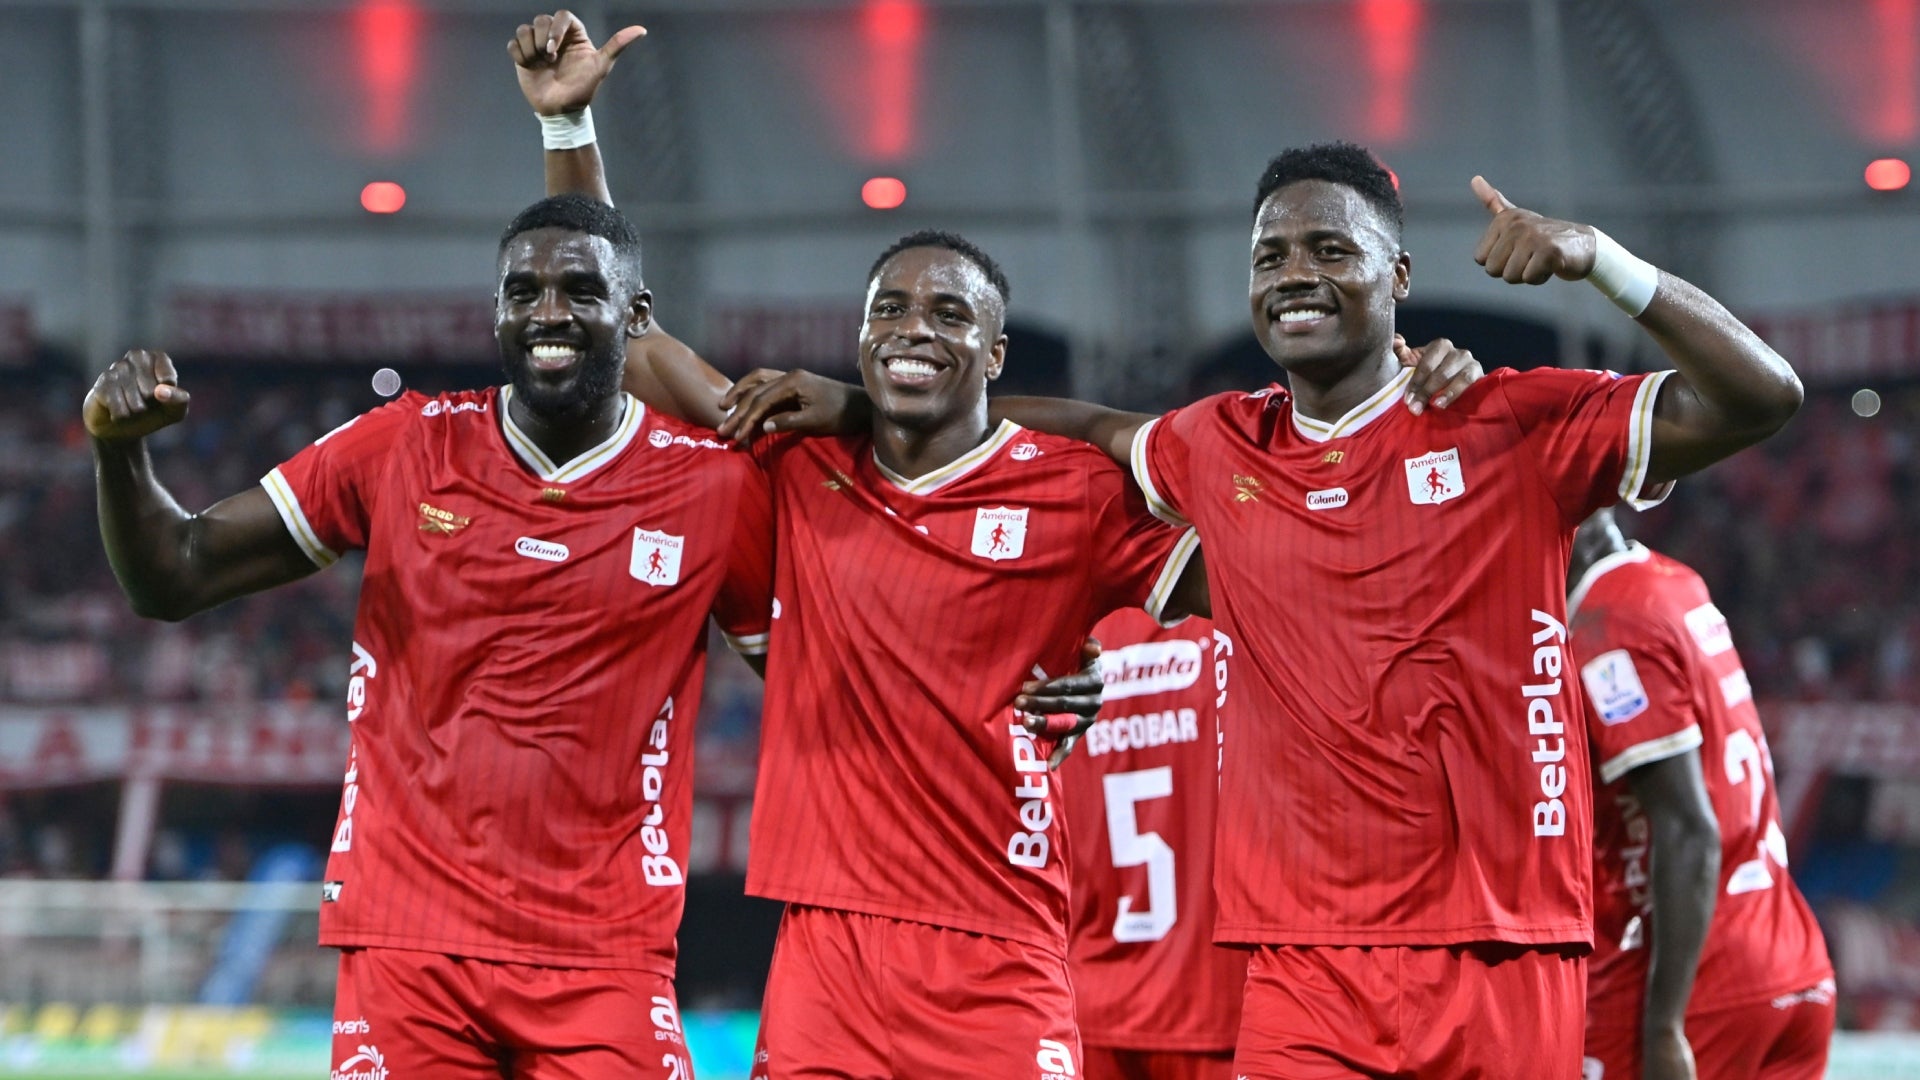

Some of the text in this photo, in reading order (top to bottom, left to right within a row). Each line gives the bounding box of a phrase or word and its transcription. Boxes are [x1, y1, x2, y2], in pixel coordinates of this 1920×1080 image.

[1410, 453, 1455, 470] América
[1307, 494, 1347, 506] Colanta
[980, 511, 1023, 522] América
[517, 540, 567, 559] Colanta
[638, 532, 679, 549] América
[1103, 655, 1197, 686] olanta
[1085, 707, 1199, 757] ESCOBAR
[1521, 608, 1567, 837] BetPlay
[1102, 765, 1178, 943] 5
